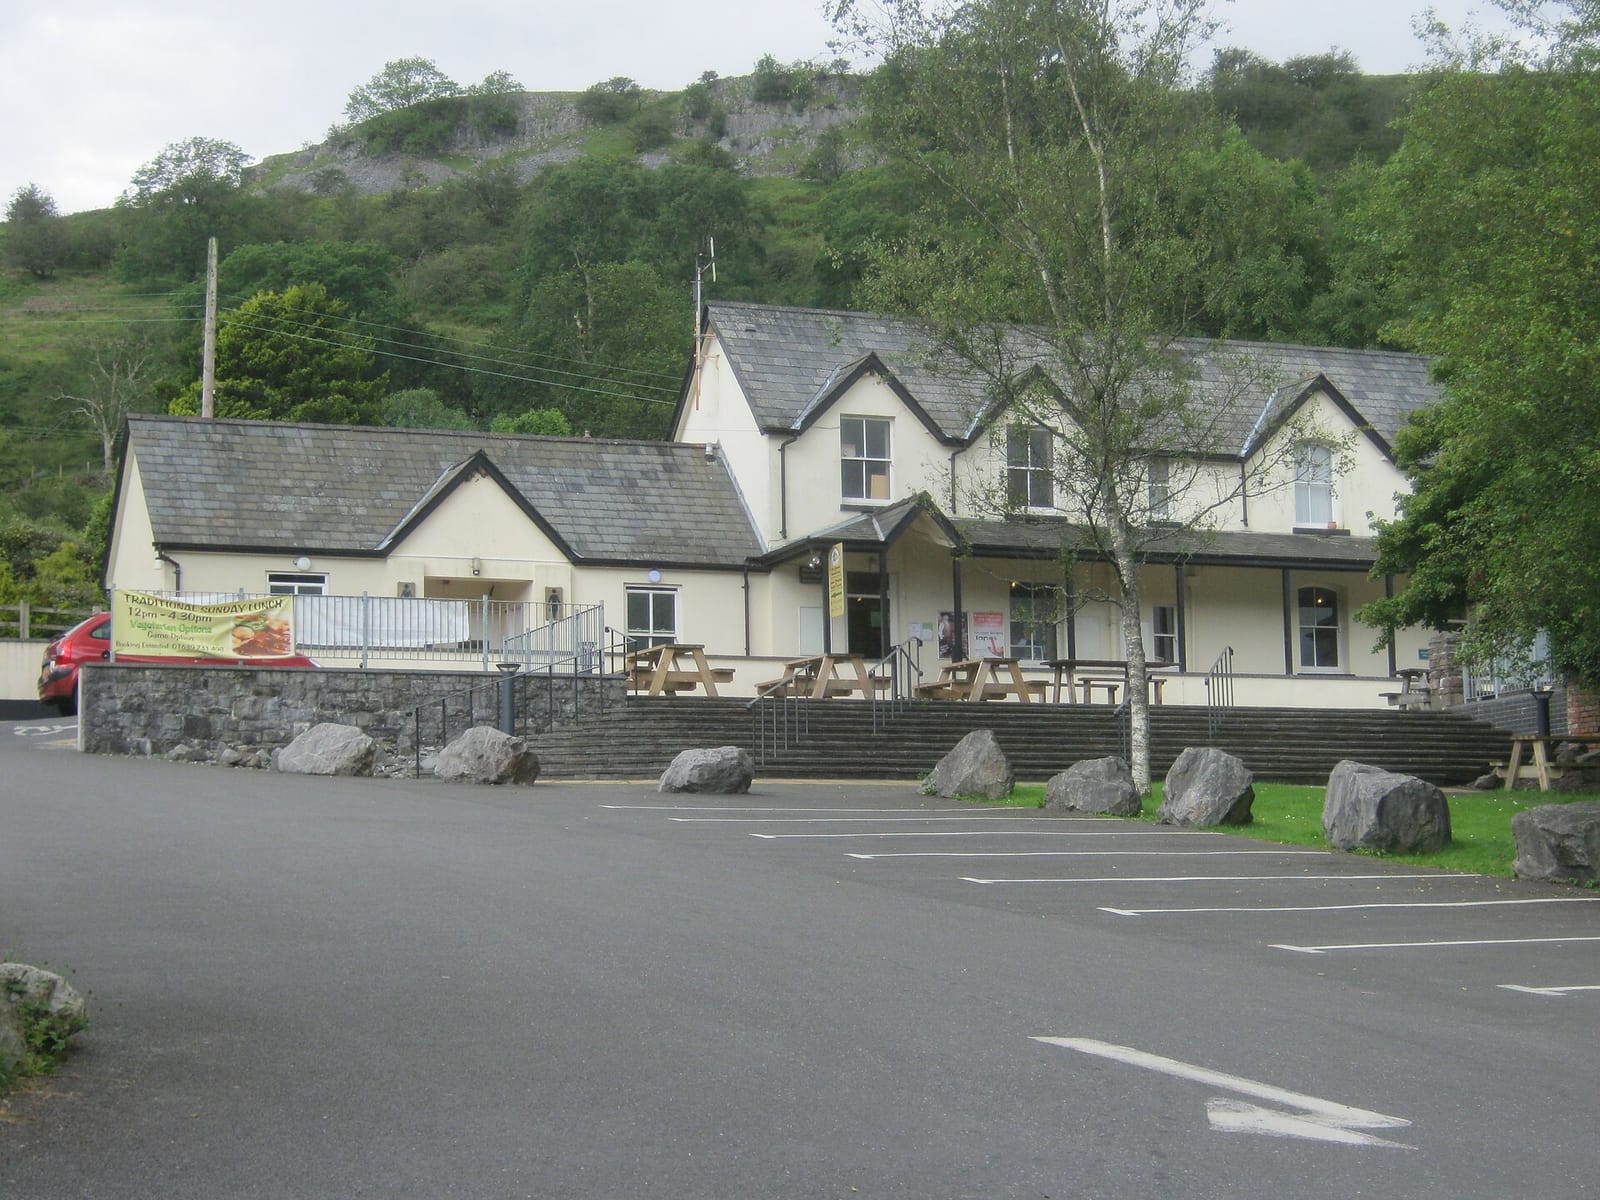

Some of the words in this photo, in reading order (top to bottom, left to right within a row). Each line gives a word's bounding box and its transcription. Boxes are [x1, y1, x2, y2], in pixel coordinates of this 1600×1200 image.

[124, 594, 196, 612] TRADITIONAL
[200, 604, 246, 614] SUNDAY
[248, 599, 283, 612] LUNCH
[128, 606, 158, 619] 12pm
[130, 619, 177, 631] Vegetarian
[178, 623, 213, 635] Options
